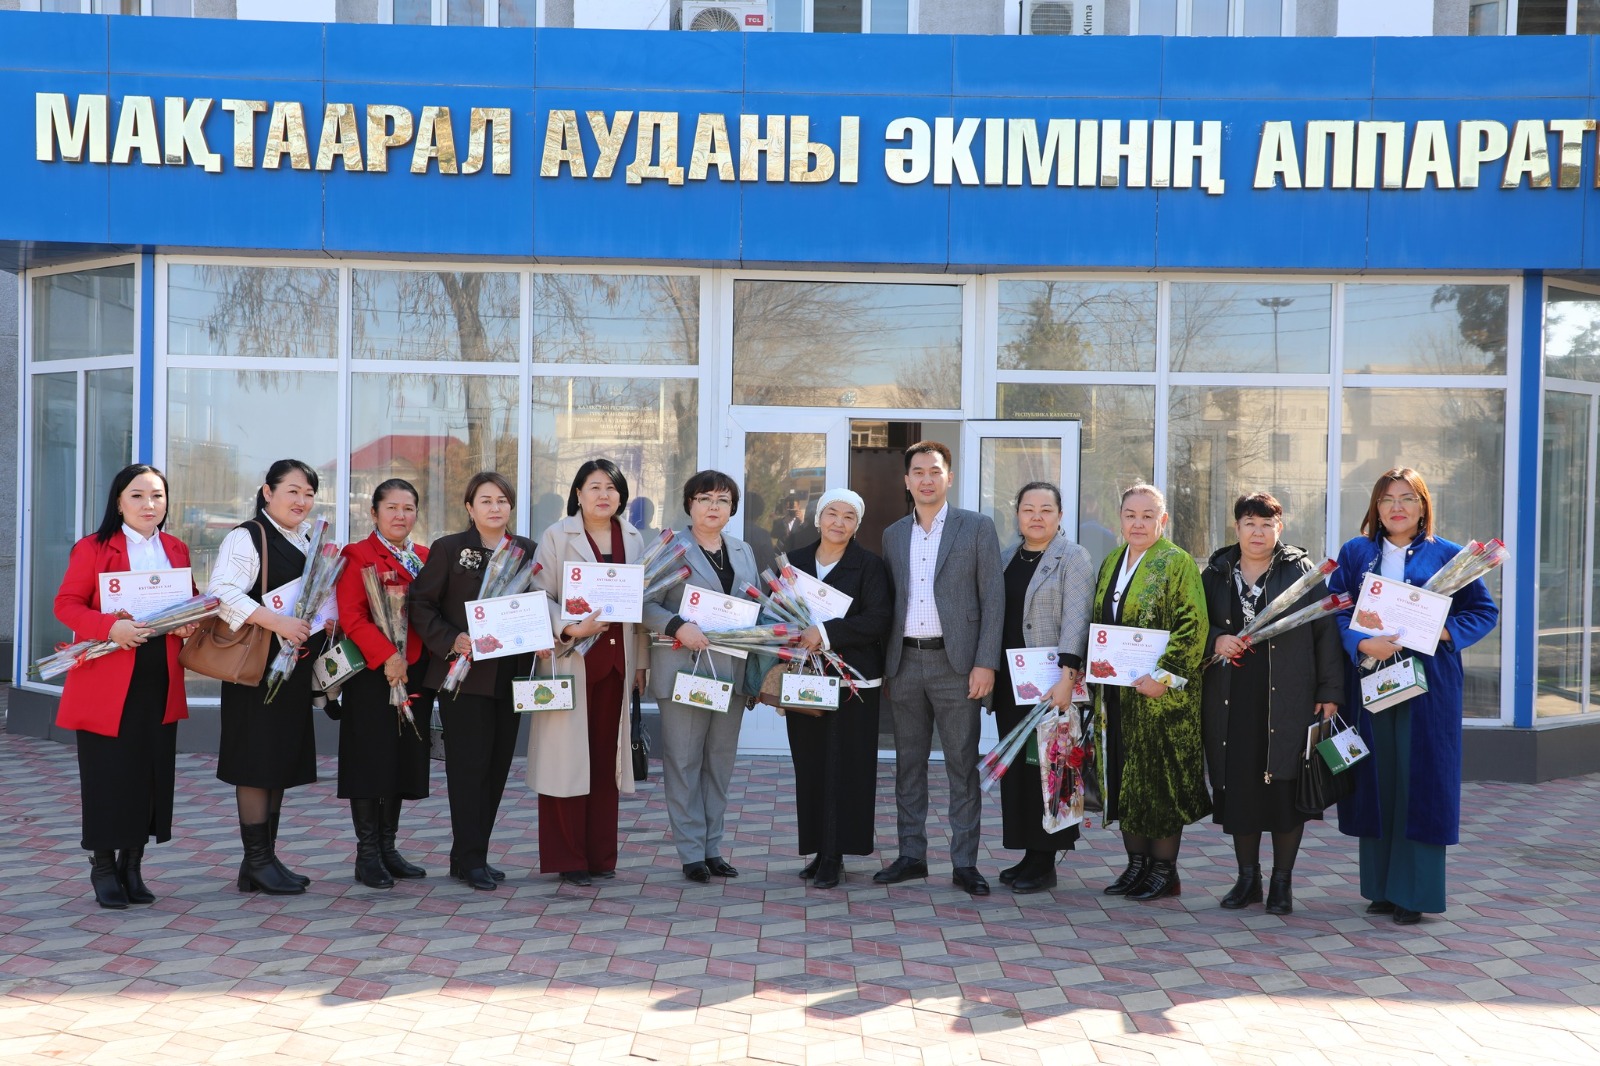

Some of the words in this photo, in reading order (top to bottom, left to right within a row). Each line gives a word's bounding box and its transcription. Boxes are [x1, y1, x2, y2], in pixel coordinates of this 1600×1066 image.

[36, 93, 511, 174] МАҚТААРАЛ
[540, 110, 859, 185] АУДАНЫ
[885, 117, 1225, 194] ӘКІМІНІҢ
[1254, 119, 1600, 188] АППАРАТ
[571, 568, 582, 581] 8
[109, 578, 121, 593] 8
[1370, 581, 1383, 595] 8
[272, 595, 283, 609] 8
[689, 592, 700, 605] 8
[474, 606, 485, 620] 8
[1097, 630, 1108, 644] 8
[1015, 654, 1025, 668] 8
